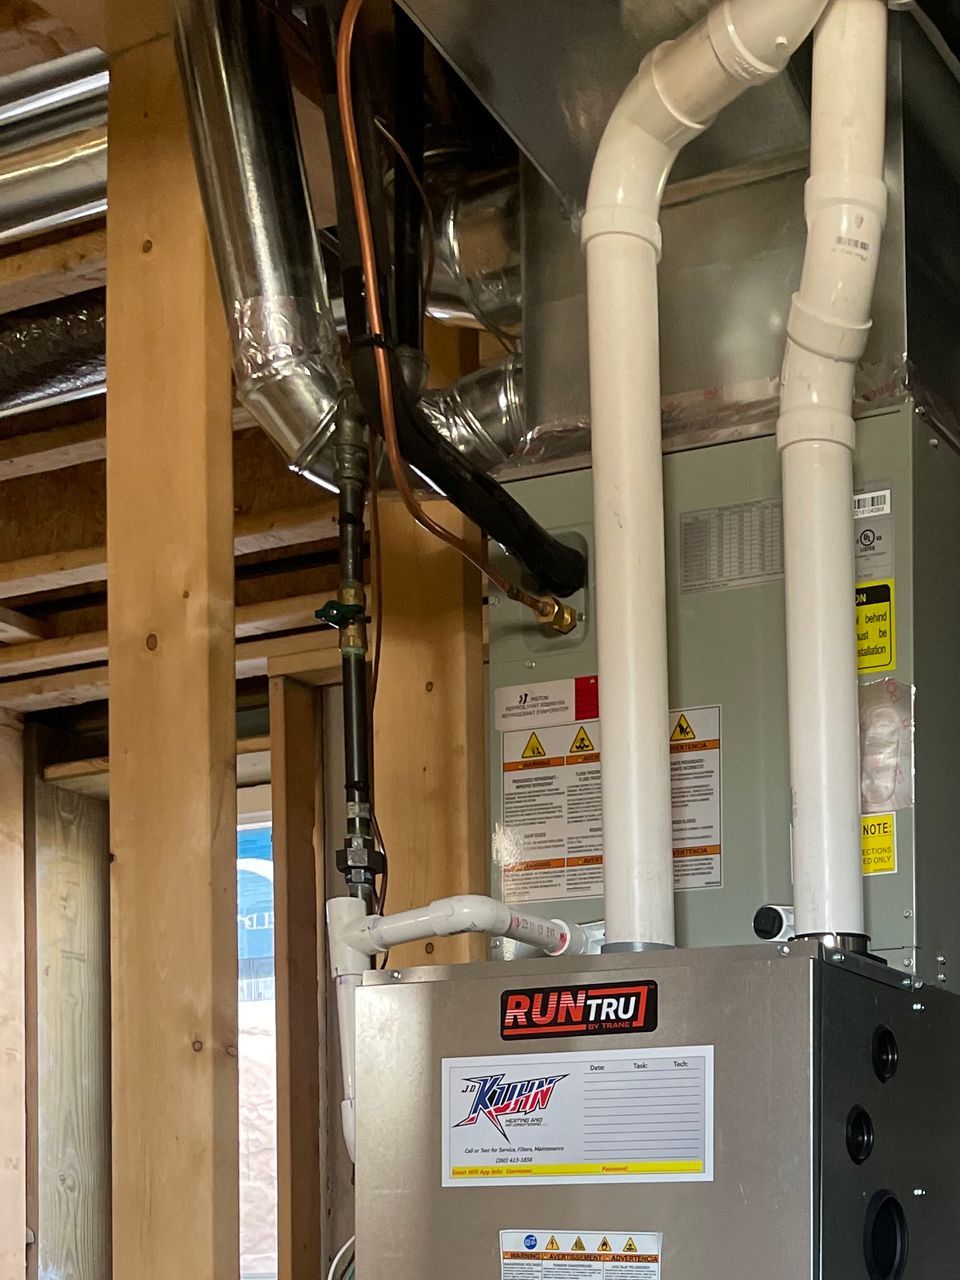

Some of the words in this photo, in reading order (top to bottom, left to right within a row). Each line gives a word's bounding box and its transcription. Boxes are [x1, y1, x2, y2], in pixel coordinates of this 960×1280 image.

[865, 611, 887, 623] behind
[879, 628, 887, 638] be
[863, 822, 892, 836] NOTE:
[862, 847, 892, 856] ECTIONS
[873, 855, 891, 864] ONLY
[601, 1021, 631, 1029] TRANE
[590, 1064, 606, 1072] Date:
[633, 1062, 648, 1070] Task:
[674, 1060, 688, 1068] Tech:
[456, 1073, 570, 1123] KUHN
[511, 1252, 540, 1260] WARNING
[550, 1253, 602, 1262] AVERTISSEMENT
[611, 1255, 658, 1263] ADVERTENCIA
